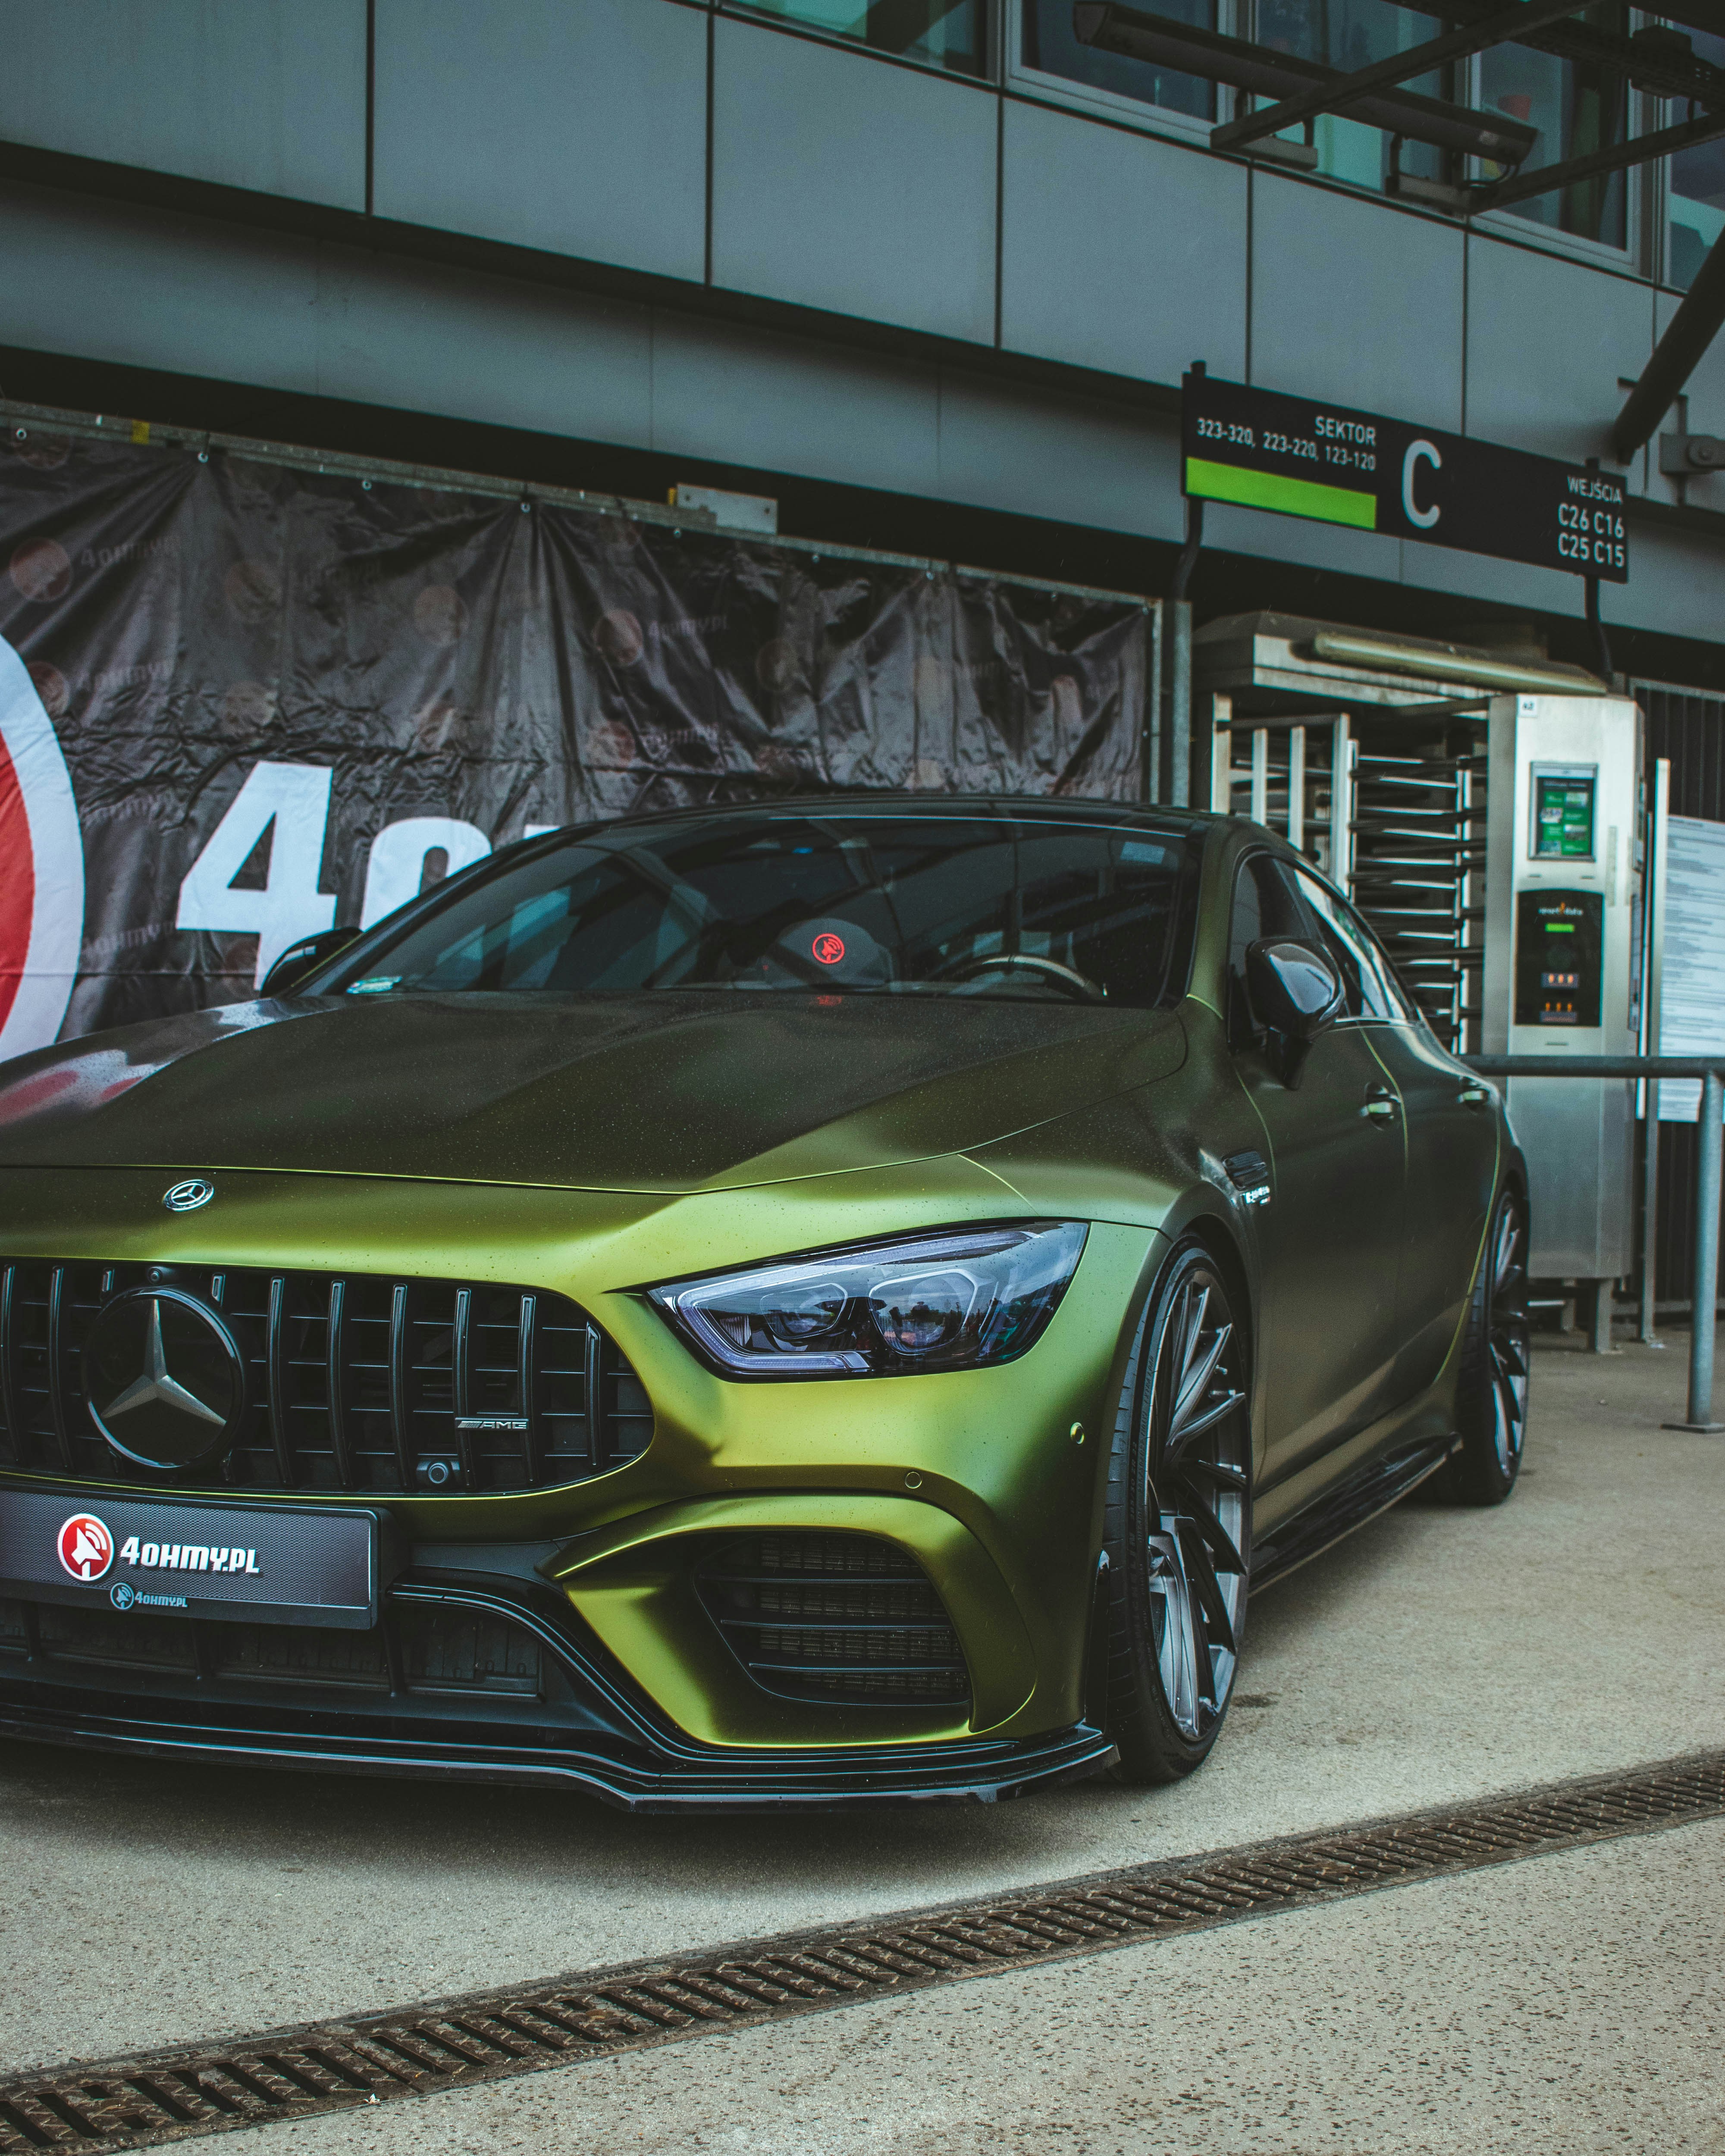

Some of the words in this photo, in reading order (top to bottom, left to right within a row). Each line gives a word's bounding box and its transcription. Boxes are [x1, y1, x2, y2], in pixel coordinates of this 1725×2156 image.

[1198, 417, 1256, 448] 323-320,
[1263, 431, 1319, 462] 223-220,
[1326, 445, 1376, 471] 123-120
[1315, 415, 1376, 447] SEKTOR
[1402, 439, 1441, 528] C
[1567, 476, 1623, 505] WEJŚCIA
[1558, 503, 1590, 531] C26
[1594, 511, 1625, 539] C16
[1558, 532, 1590, 560] C25
[1594, 540, 1625, 568] C15
